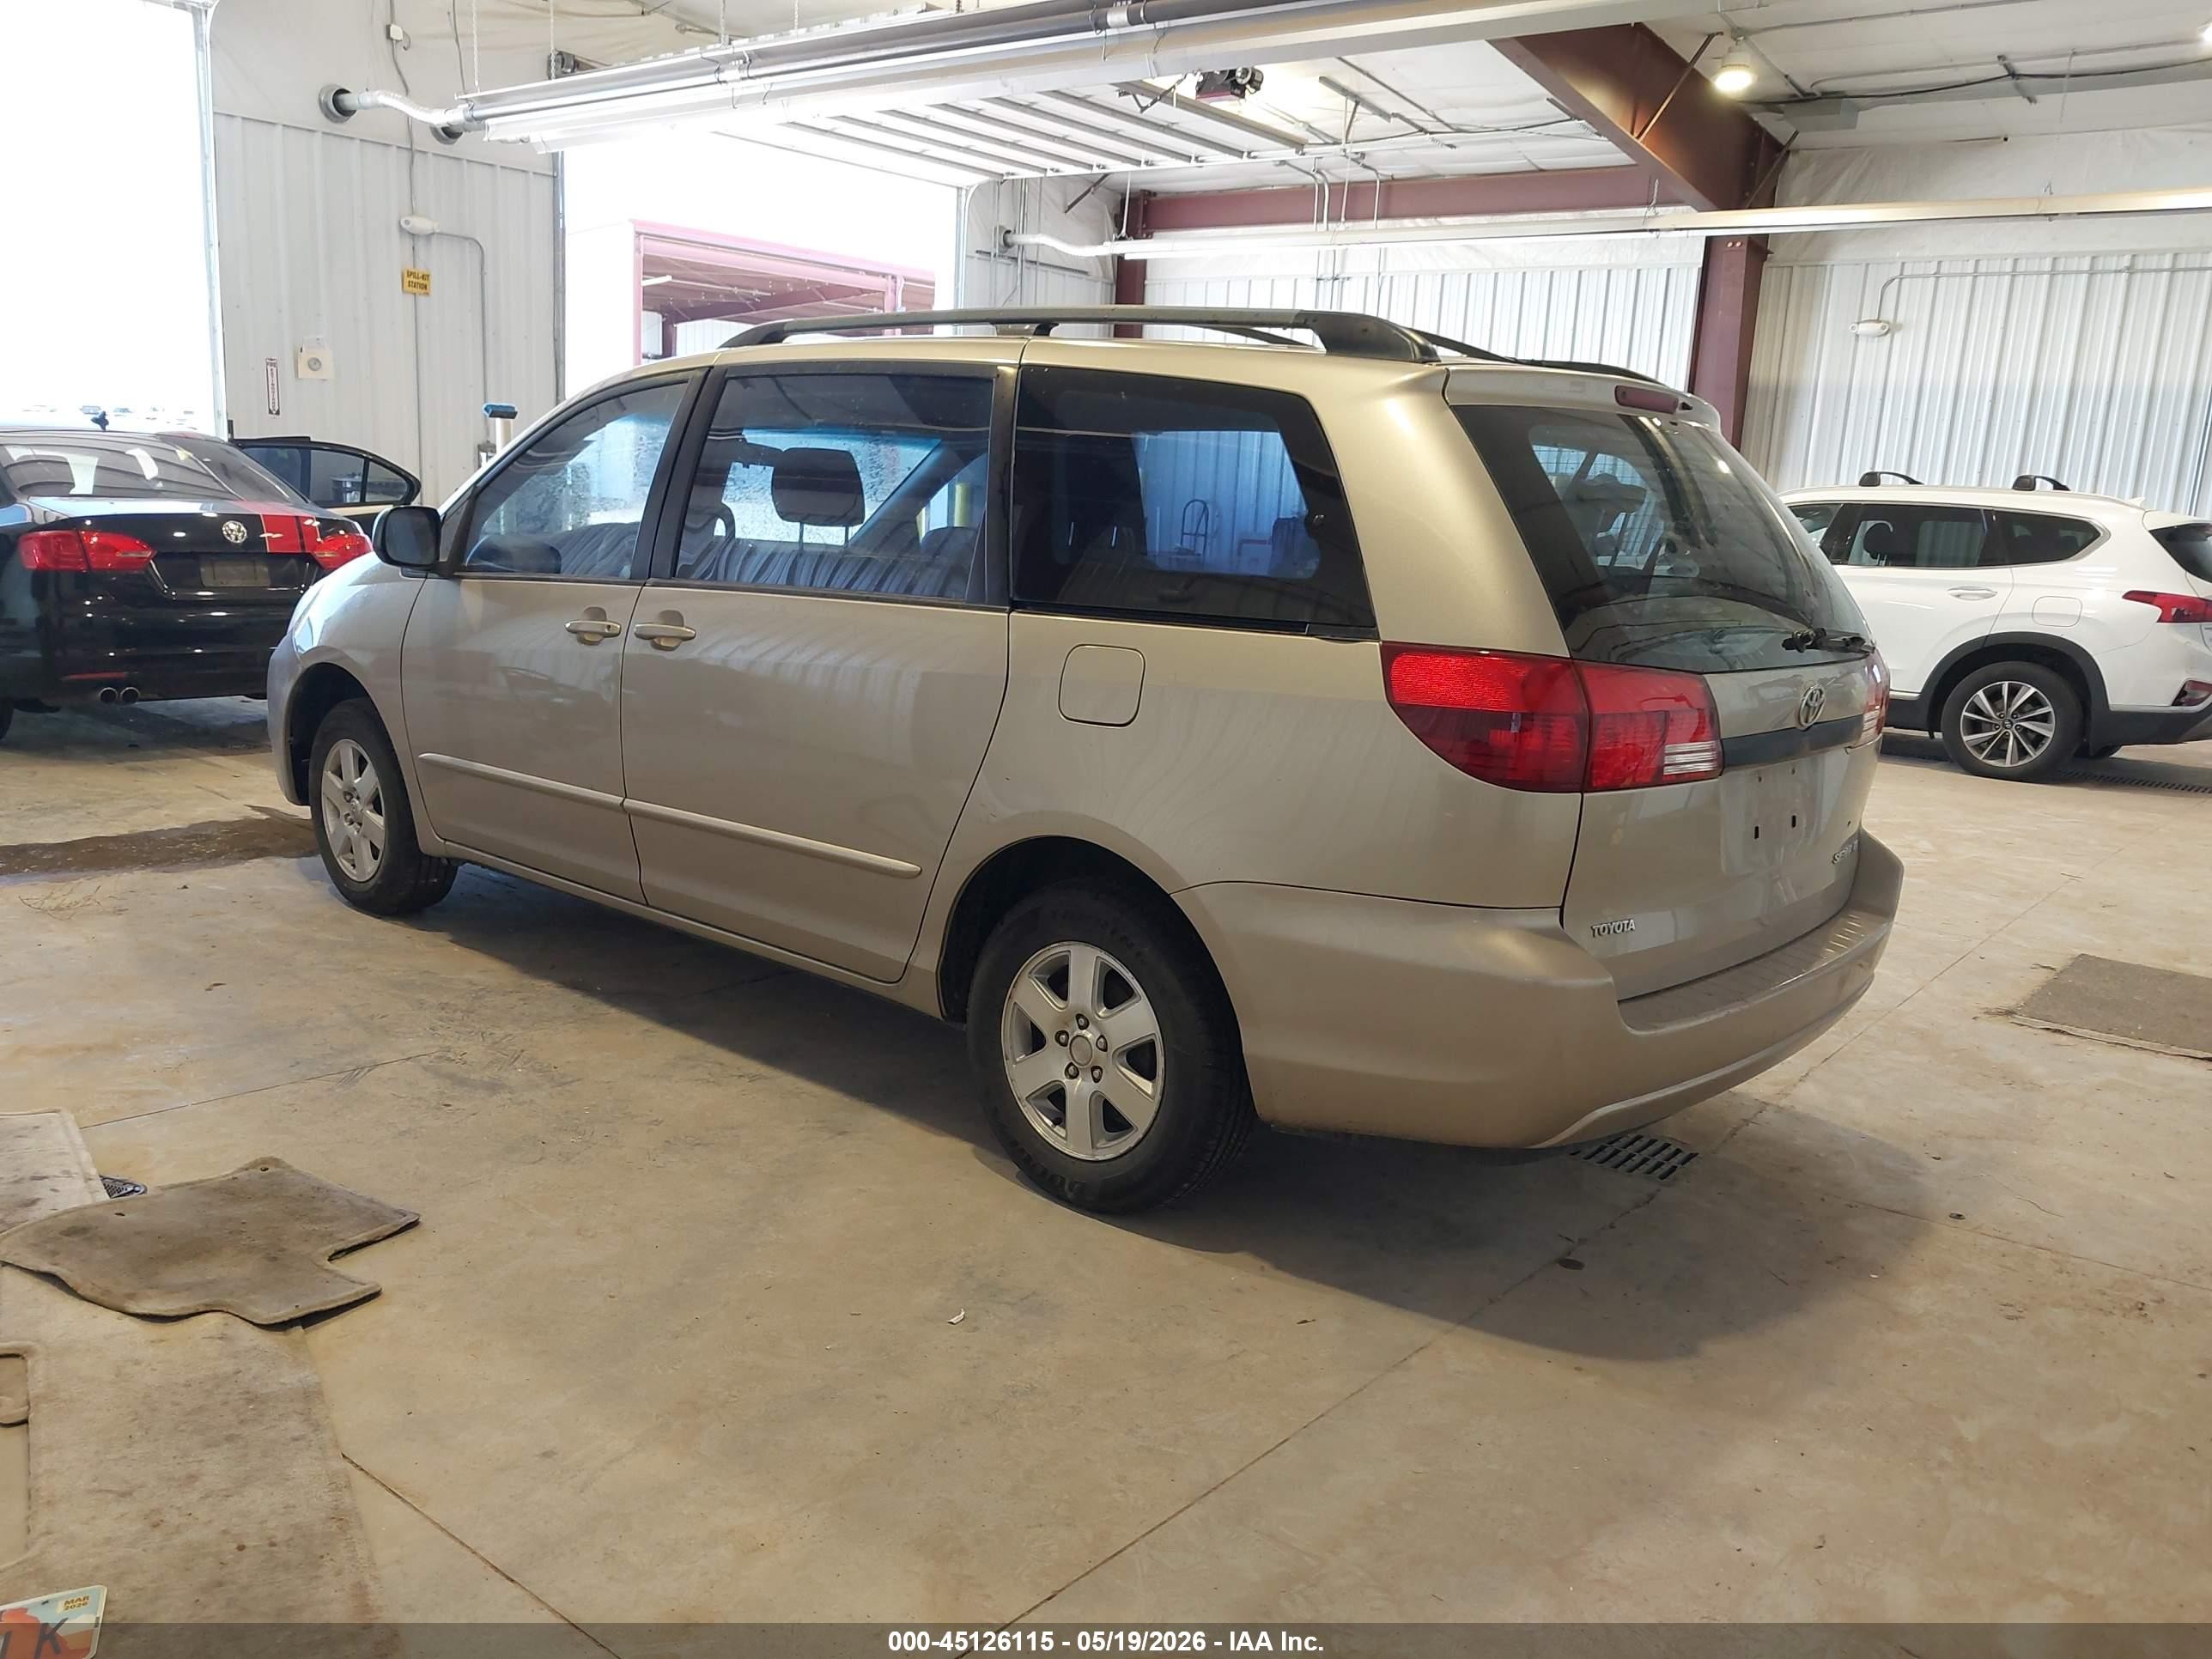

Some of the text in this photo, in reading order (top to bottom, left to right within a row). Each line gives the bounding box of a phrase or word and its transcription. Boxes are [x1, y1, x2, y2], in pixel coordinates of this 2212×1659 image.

[406, 270, 429, 282] SPILL-KIT
[408, 280, 428, 291] STATION
[1590, 918, 1636, 938] TOYOTA
[64, 1595, 90, 1606] MAR
